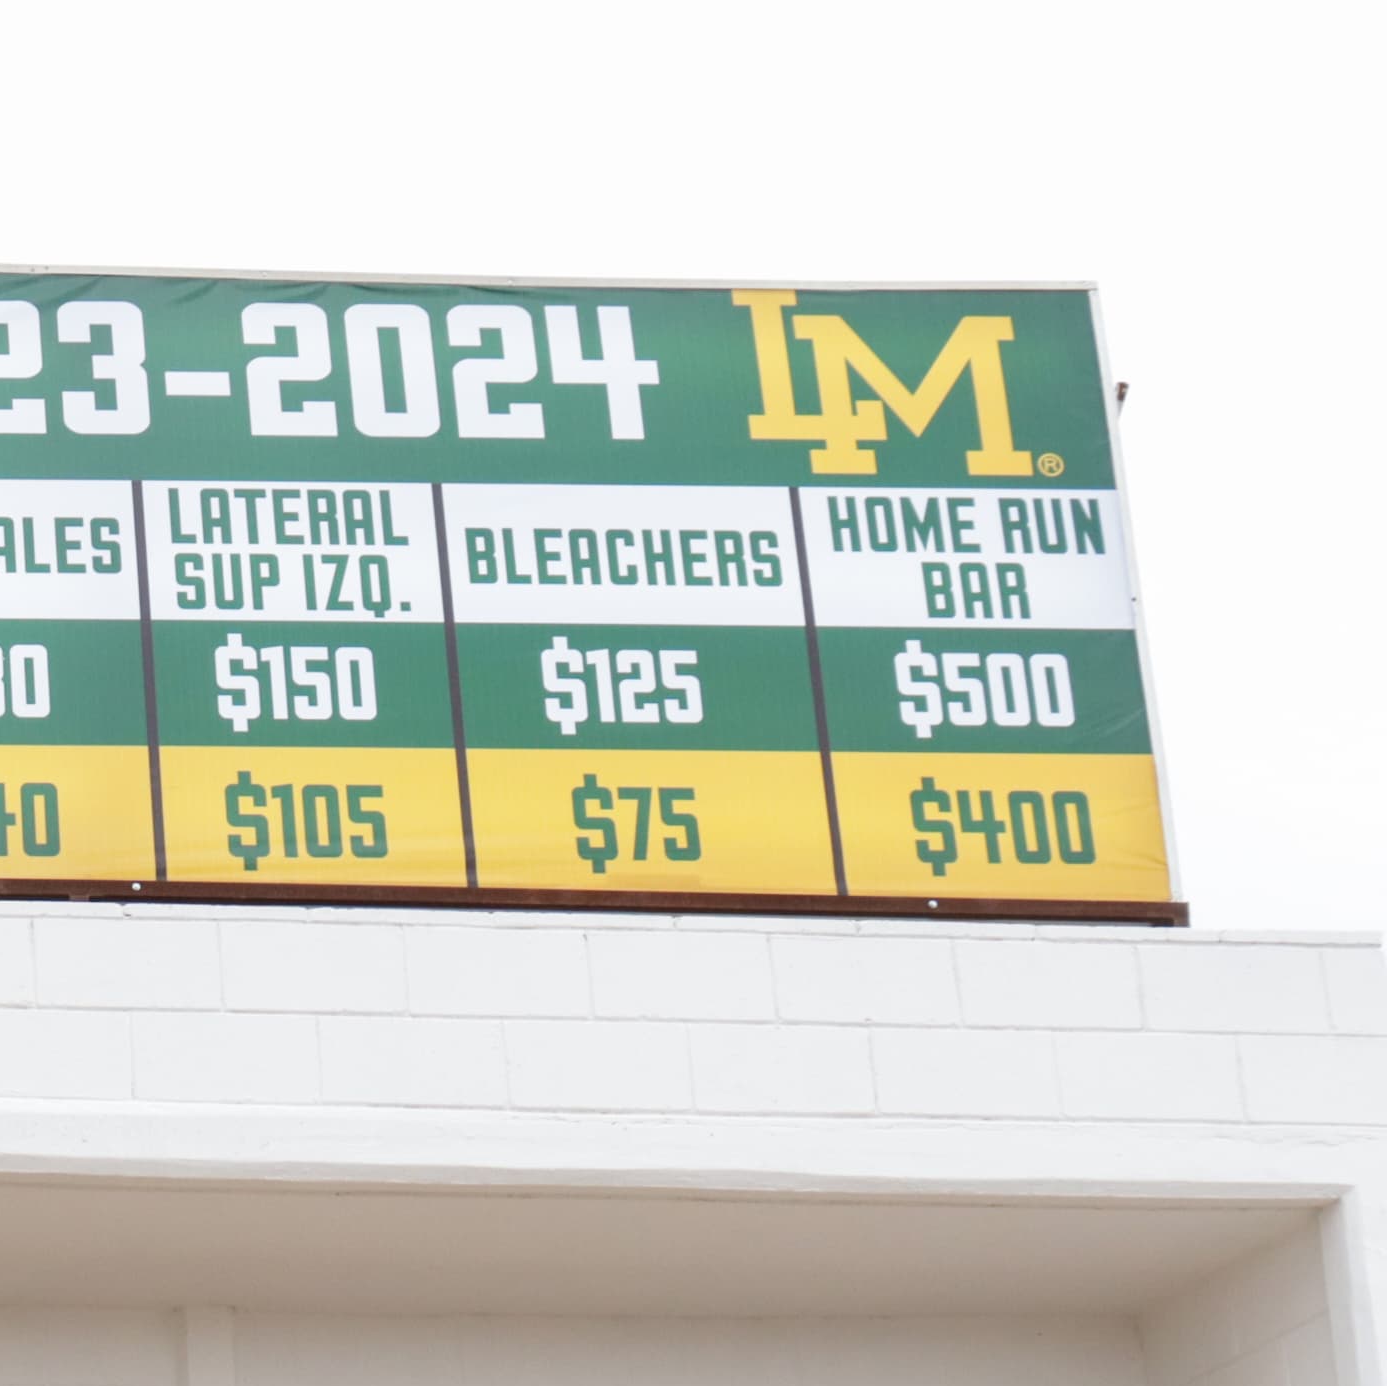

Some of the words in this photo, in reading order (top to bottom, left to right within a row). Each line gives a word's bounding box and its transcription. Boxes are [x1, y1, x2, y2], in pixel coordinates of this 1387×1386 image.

[168, 488, 408, 545] LATERAL
[465, 528, 782, 586] BLEACHERS
[828, 497, 981, 553] HOME
[999, 498, 1105, 554] RUN
[175, 553, 280, 610] SUP
[303, 554, 411, 618] IZQ.
[922, 563, 1030, 619] BAR
[215, 634, 377, 732] $150
[541, 637, 703, 735] $125
[894, 640, 1075, 738] $500
[225, 771, 388, 871] $105
[572, 774, 701, 873] $75
[910, 777, 1096, 876] $400
